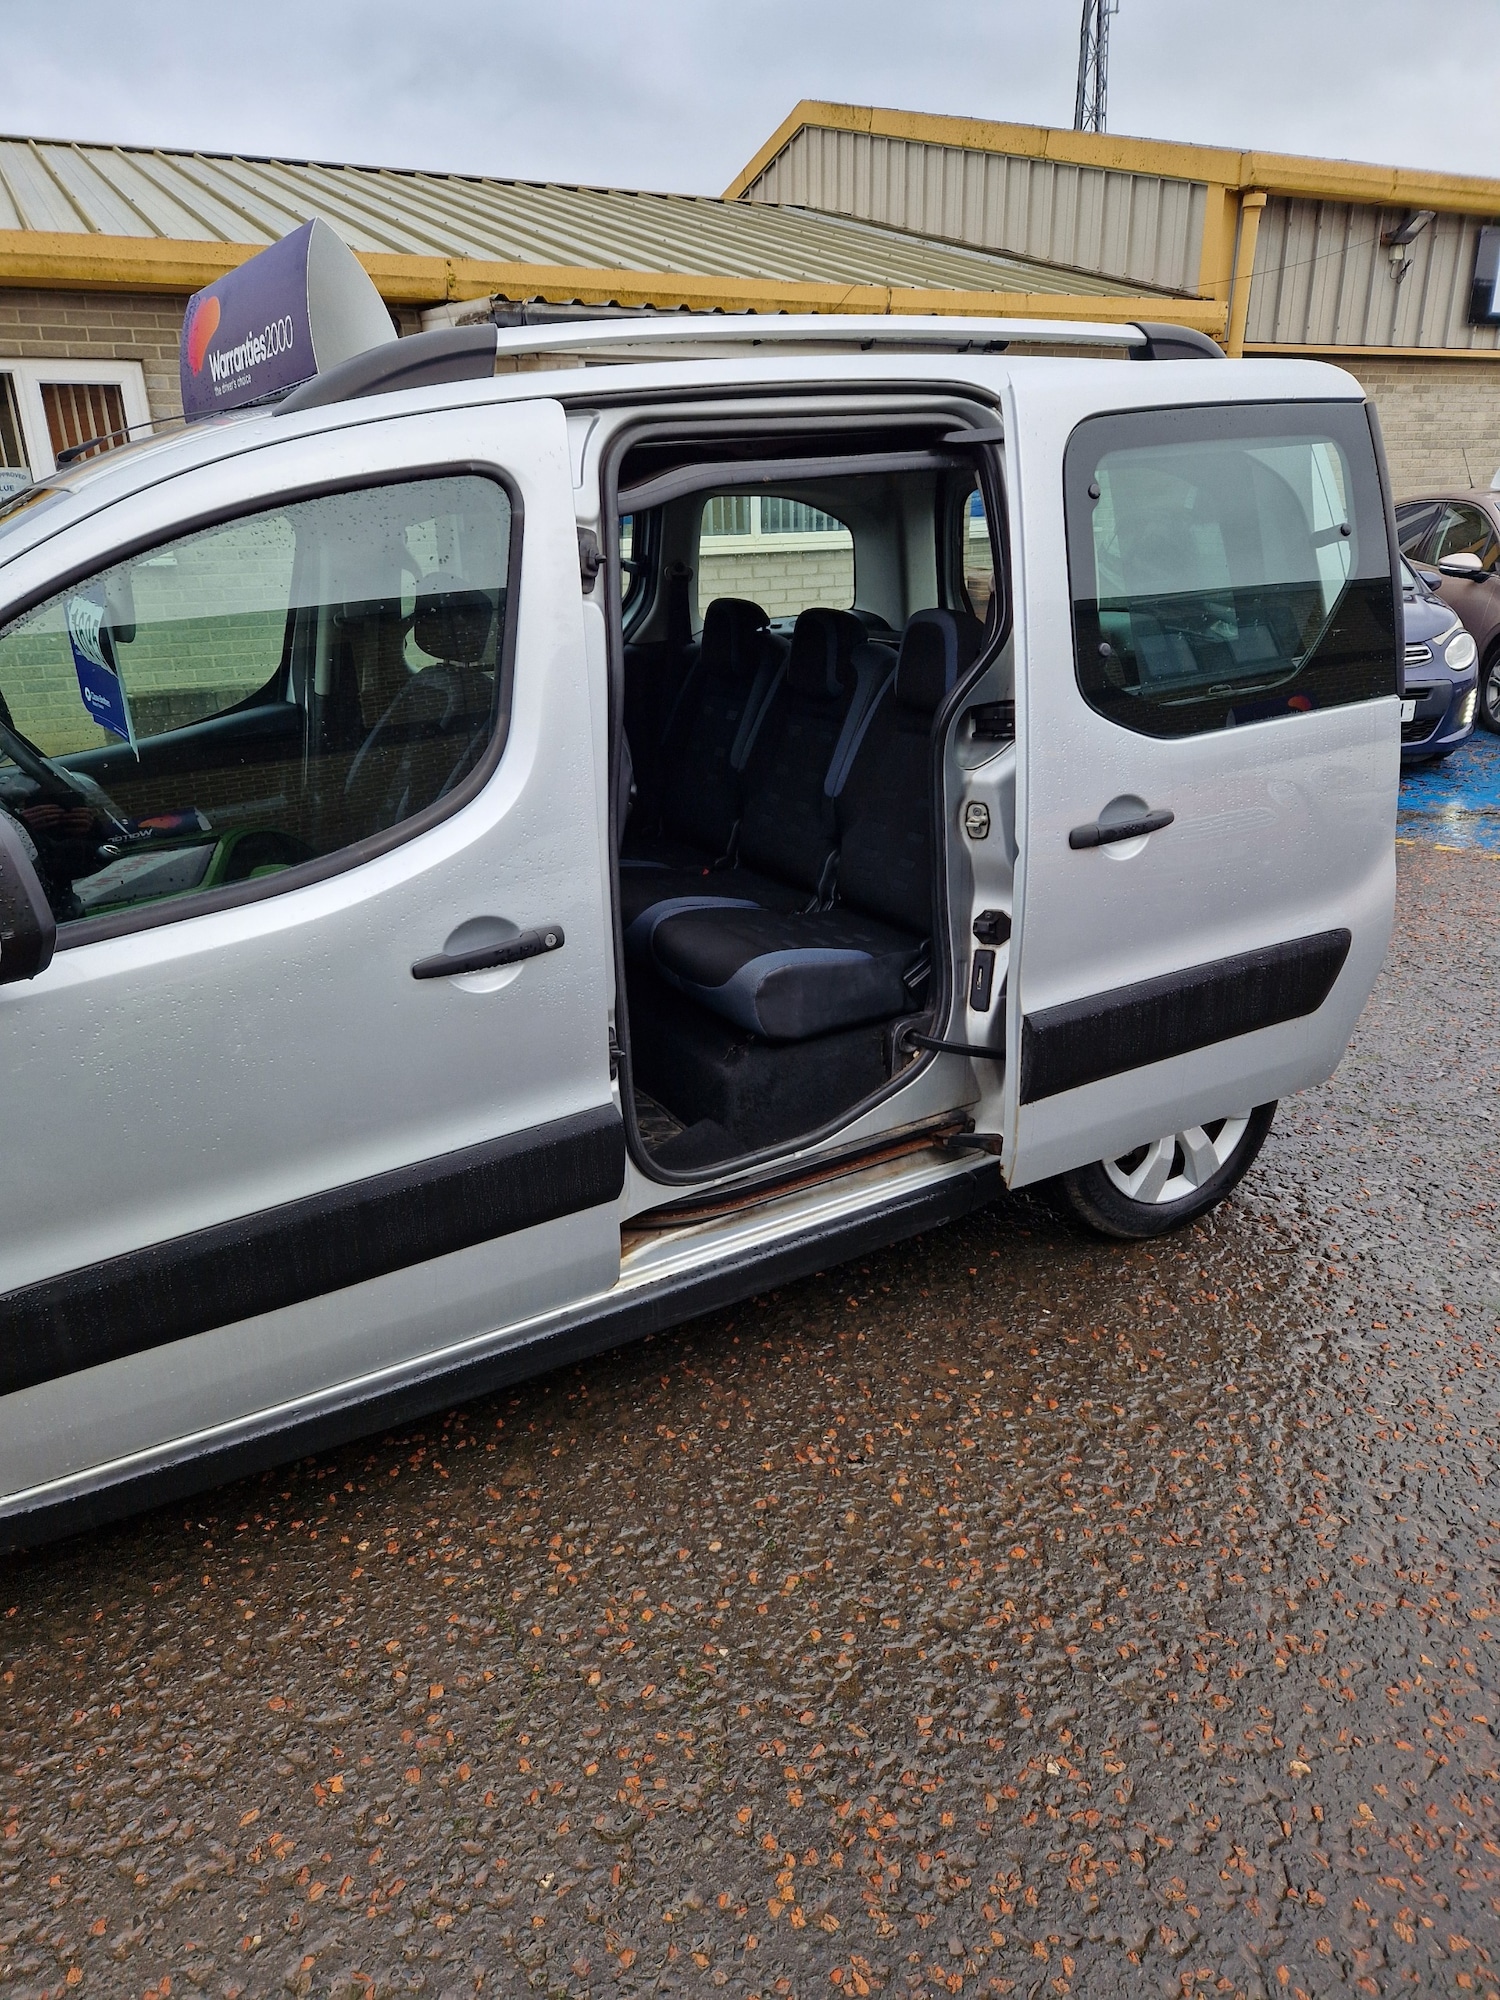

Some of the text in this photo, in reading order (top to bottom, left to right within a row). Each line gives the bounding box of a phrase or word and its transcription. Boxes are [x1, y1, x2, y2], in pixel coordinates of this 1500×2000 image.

[208, 315, 293, 382] Warranties2000
[214, 373, 252, 397] the driver's choice
